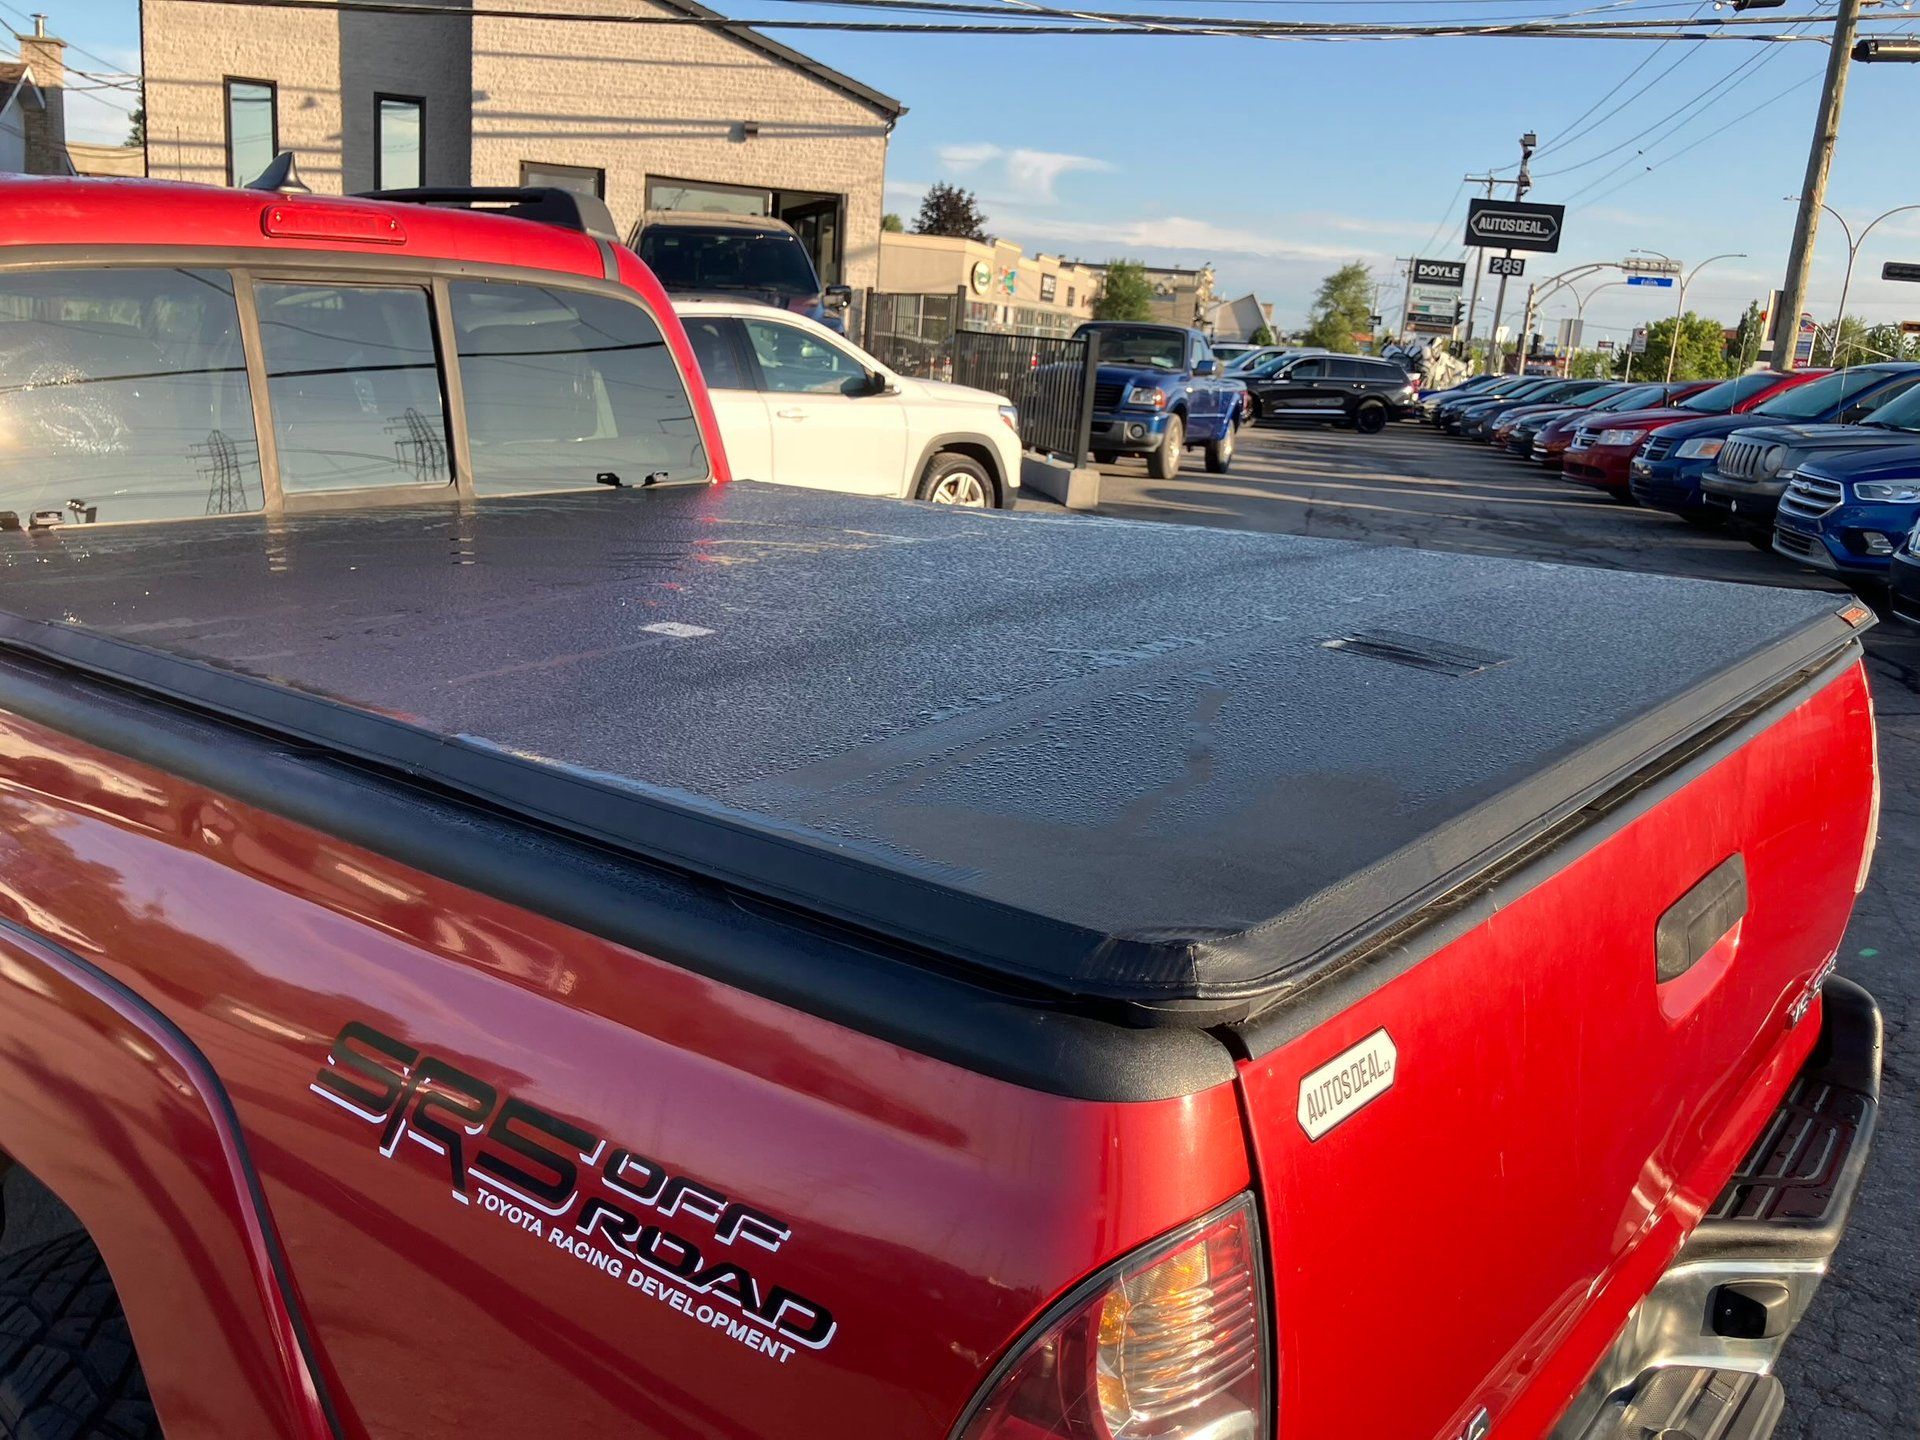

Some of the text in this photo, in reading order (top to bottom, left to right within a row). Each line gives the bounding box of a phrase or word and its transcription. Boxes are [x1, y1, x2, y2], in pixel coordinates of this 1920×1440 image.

[1418, 264, 1460, 278] DOYLE
[1491, 258, 1522, 275] 289
[601, 1147, 792, 1253] OFF
[475, 1187, 796, 1364] TOYOTA RACING DEVELOPMENT
[575, 1196, 838, 1351] ROAD
